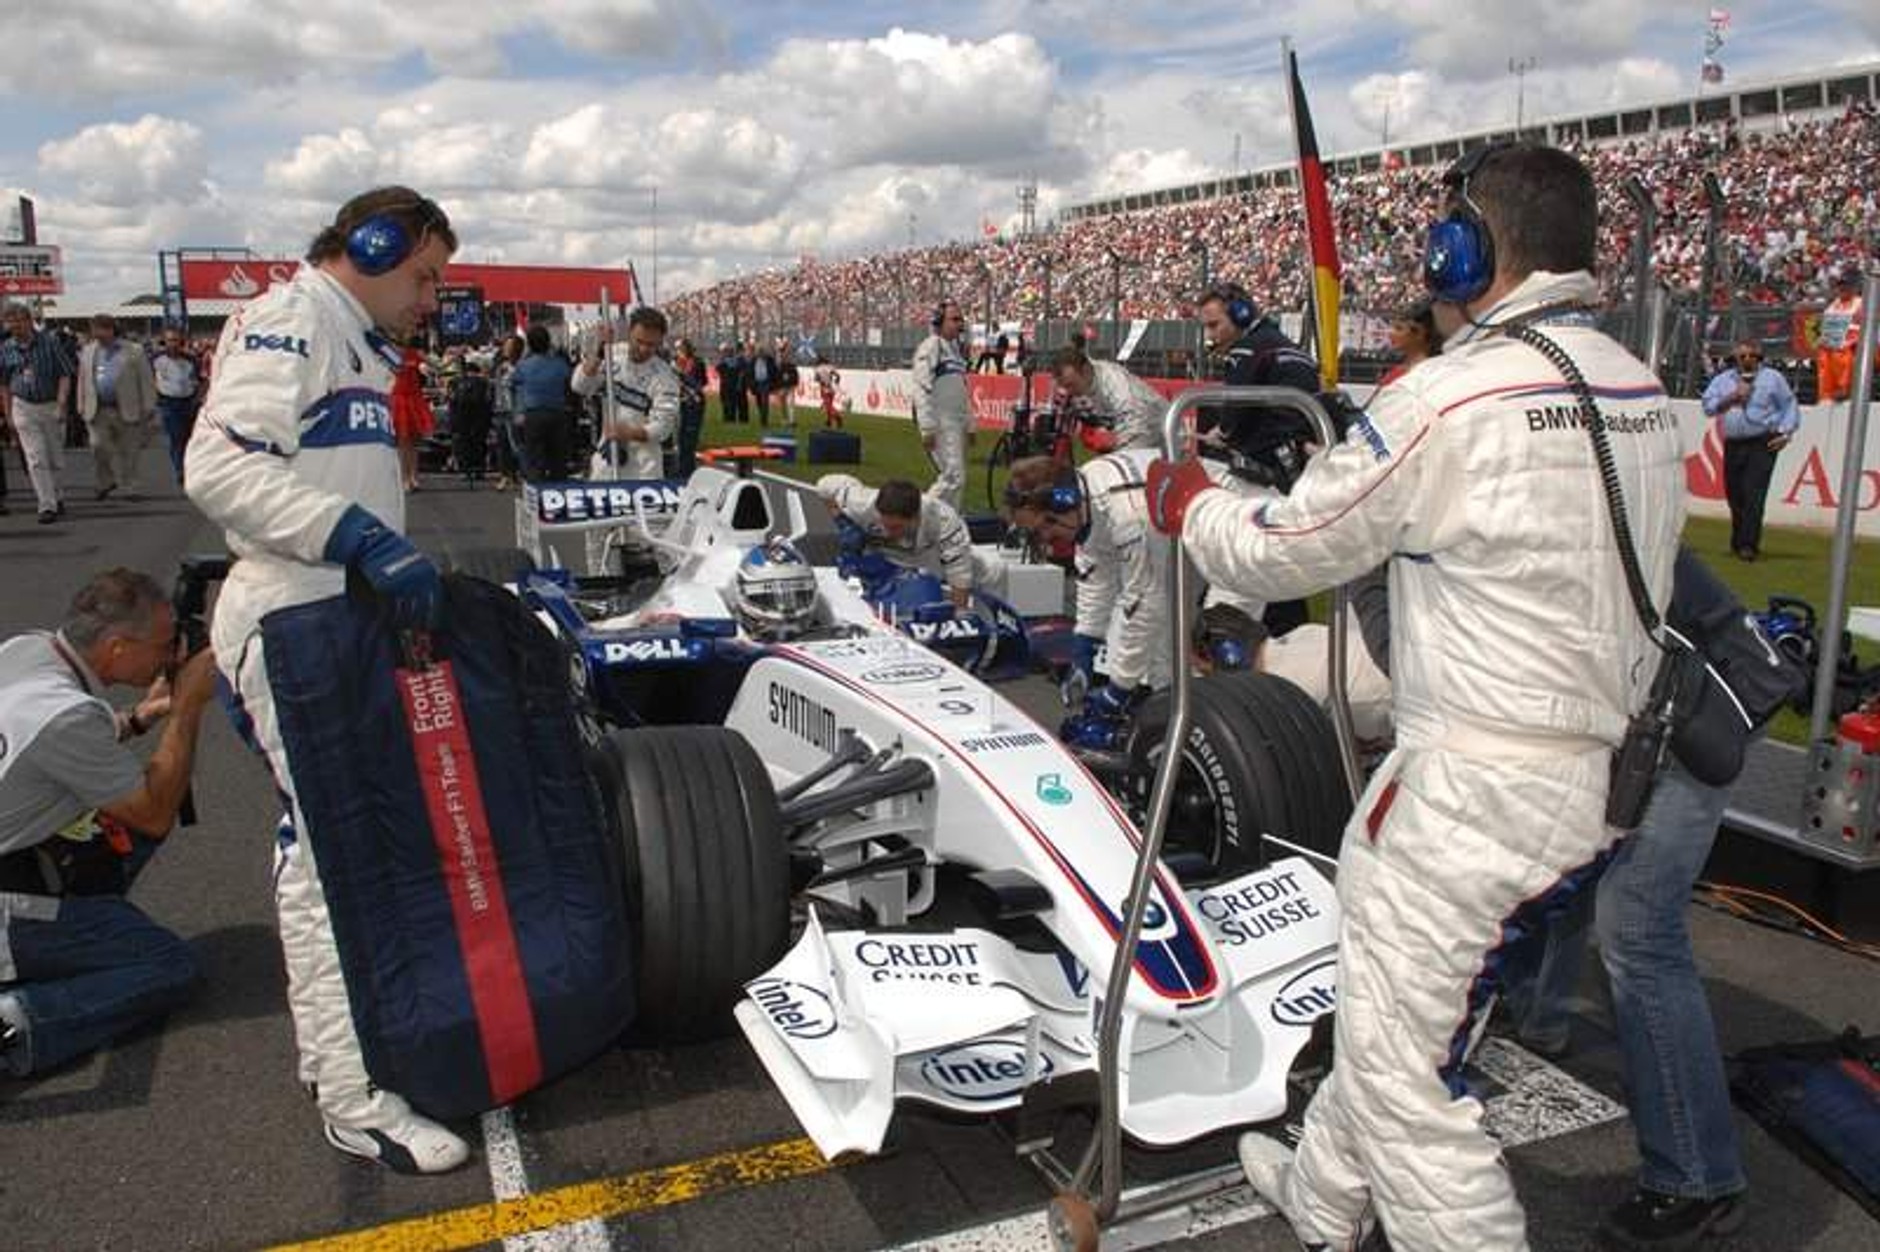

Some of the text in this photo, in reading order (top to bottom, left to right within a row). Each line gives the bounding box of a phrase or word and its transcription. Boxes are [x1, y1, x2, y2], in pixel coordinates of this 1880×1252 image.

[244, 334, 309, 358] DELL
[605, 639, 688, 662] DELL
[406, 675, 433, 733] Front
[424, 661, 453, 728] Right
[769, 681, 836, 754] SYNTIUM
[1198, 871, 1302, 922] CREDIT
[1219, 897, 1320, 946] SUISSE
[855, 940, 978, 967] CREDIT
[755, 979, 822, 1037] intel
[1275, 984, 1336, 1016] int
